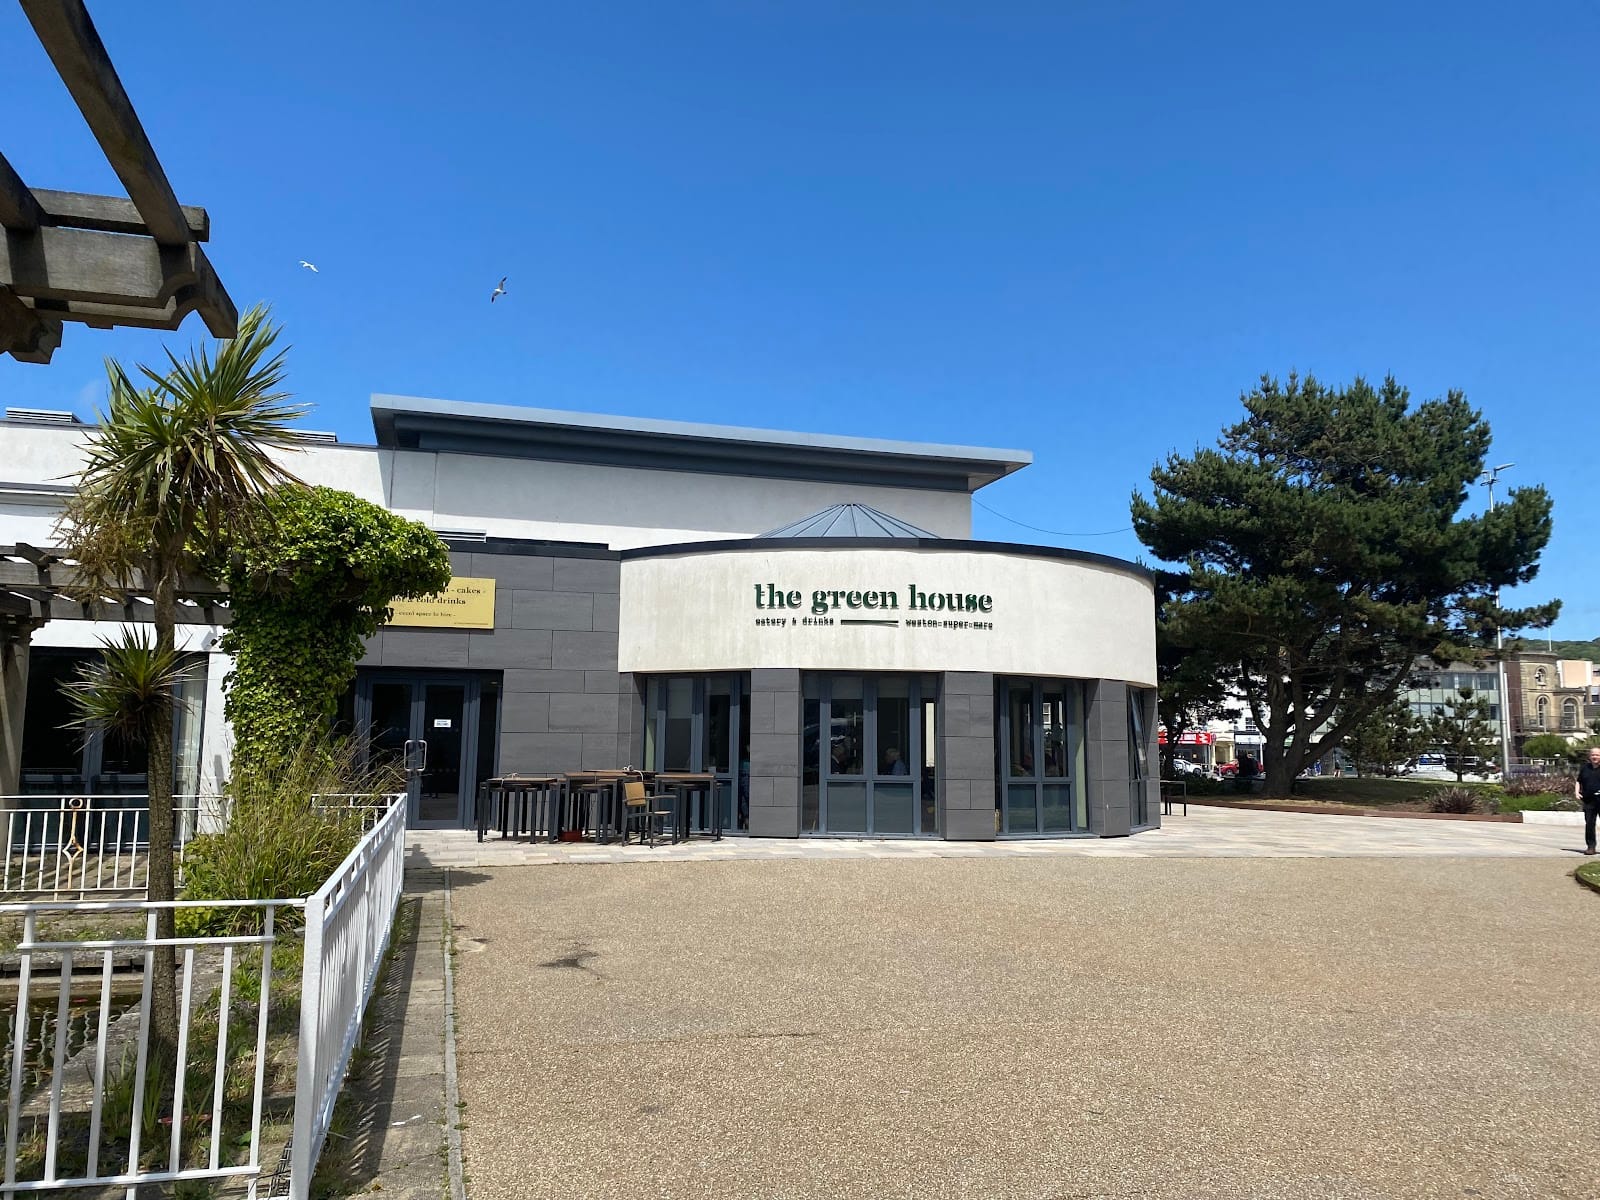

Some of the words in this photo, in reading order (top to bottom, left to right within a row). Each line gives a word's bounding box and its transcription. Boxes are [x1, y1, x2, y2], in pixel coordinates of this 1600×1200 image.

[456, 586, 481, 594] cakes
[437, 596, 466, 605] drinks
[754, 583, 802, 610] the
[811, 589, 899, 615] green
[908, 584, 993, 613] house
[755, 617, 787, 628] eatery
[791, 617, 797, 626] &
[802, 616, 834, 626] drinks
[905, 619, 993, 631] weston-super-mare
